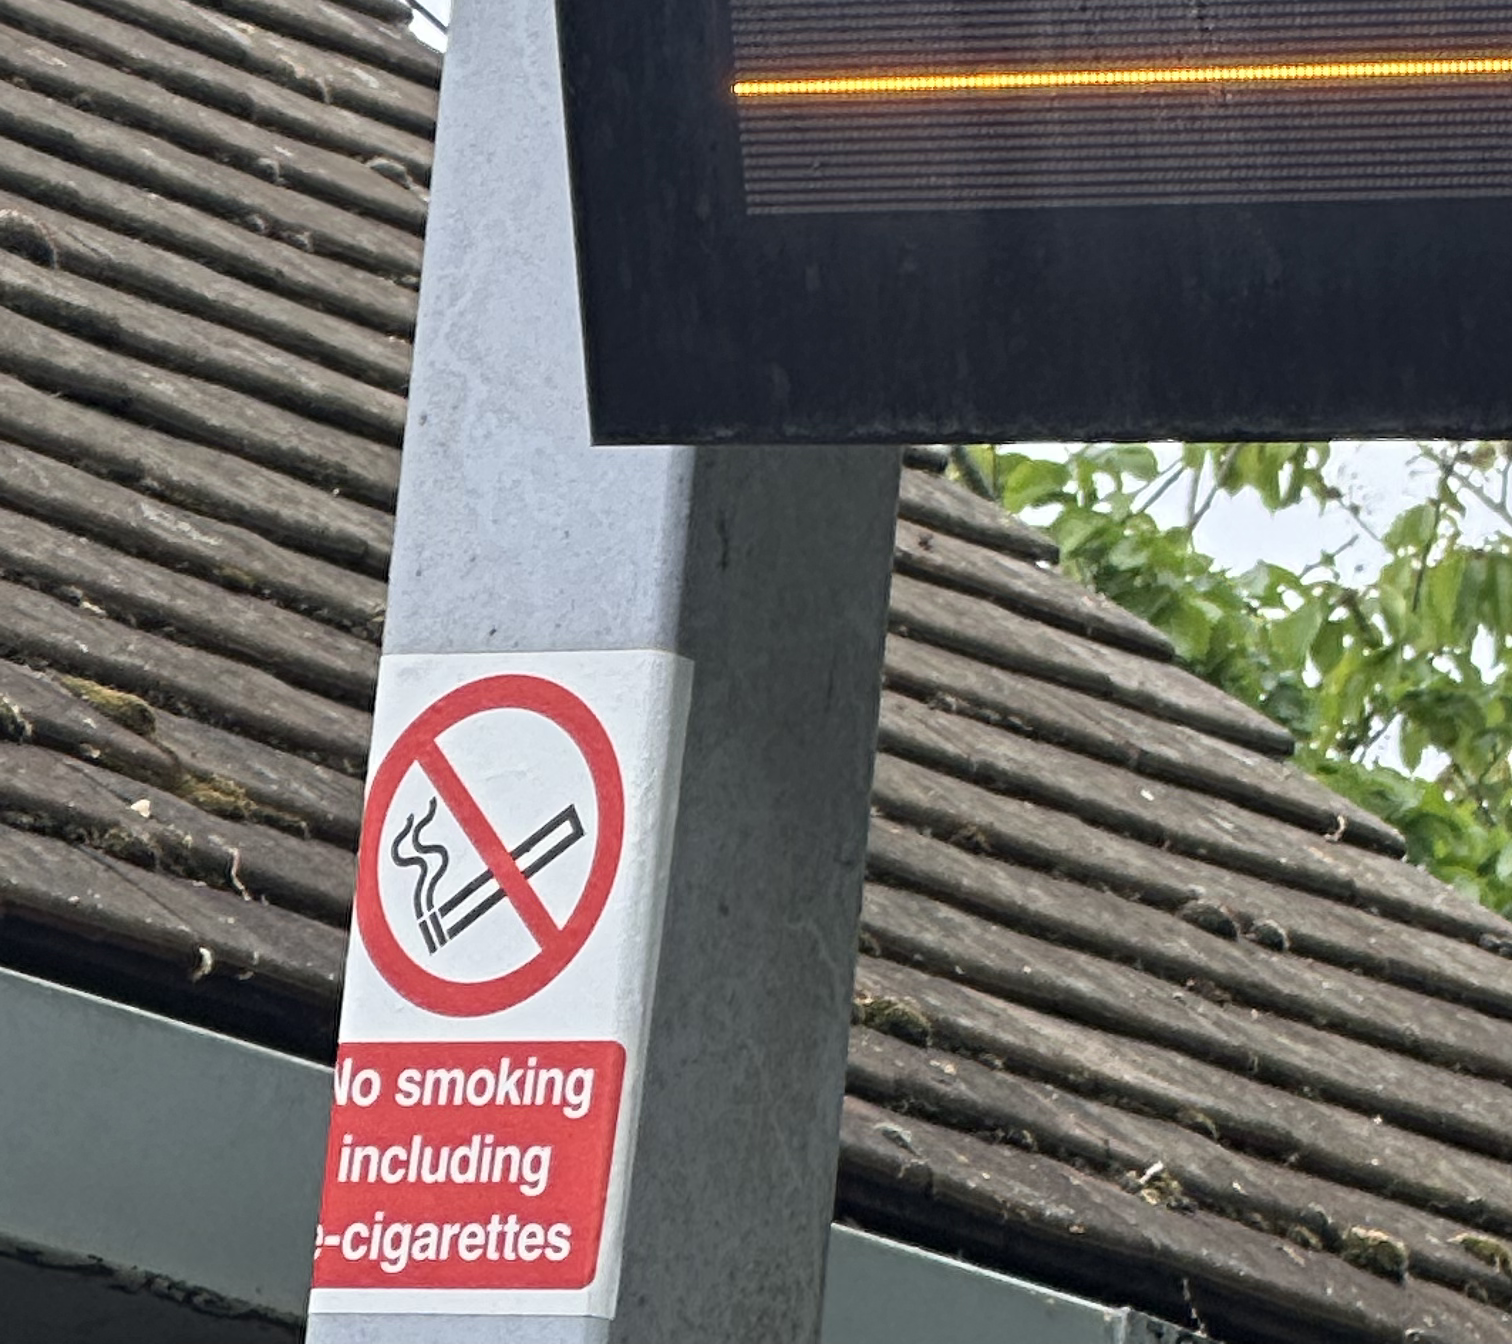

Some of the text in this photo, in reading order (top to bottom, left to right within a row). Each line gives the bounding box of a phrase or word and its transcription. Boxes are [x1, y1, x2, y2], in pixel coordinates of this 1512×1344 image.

[394, 1056, 595, 1119] smoking
[337, 1133, 552, 1196] including
[313, 1210, 572, 1273] -cigarettes
